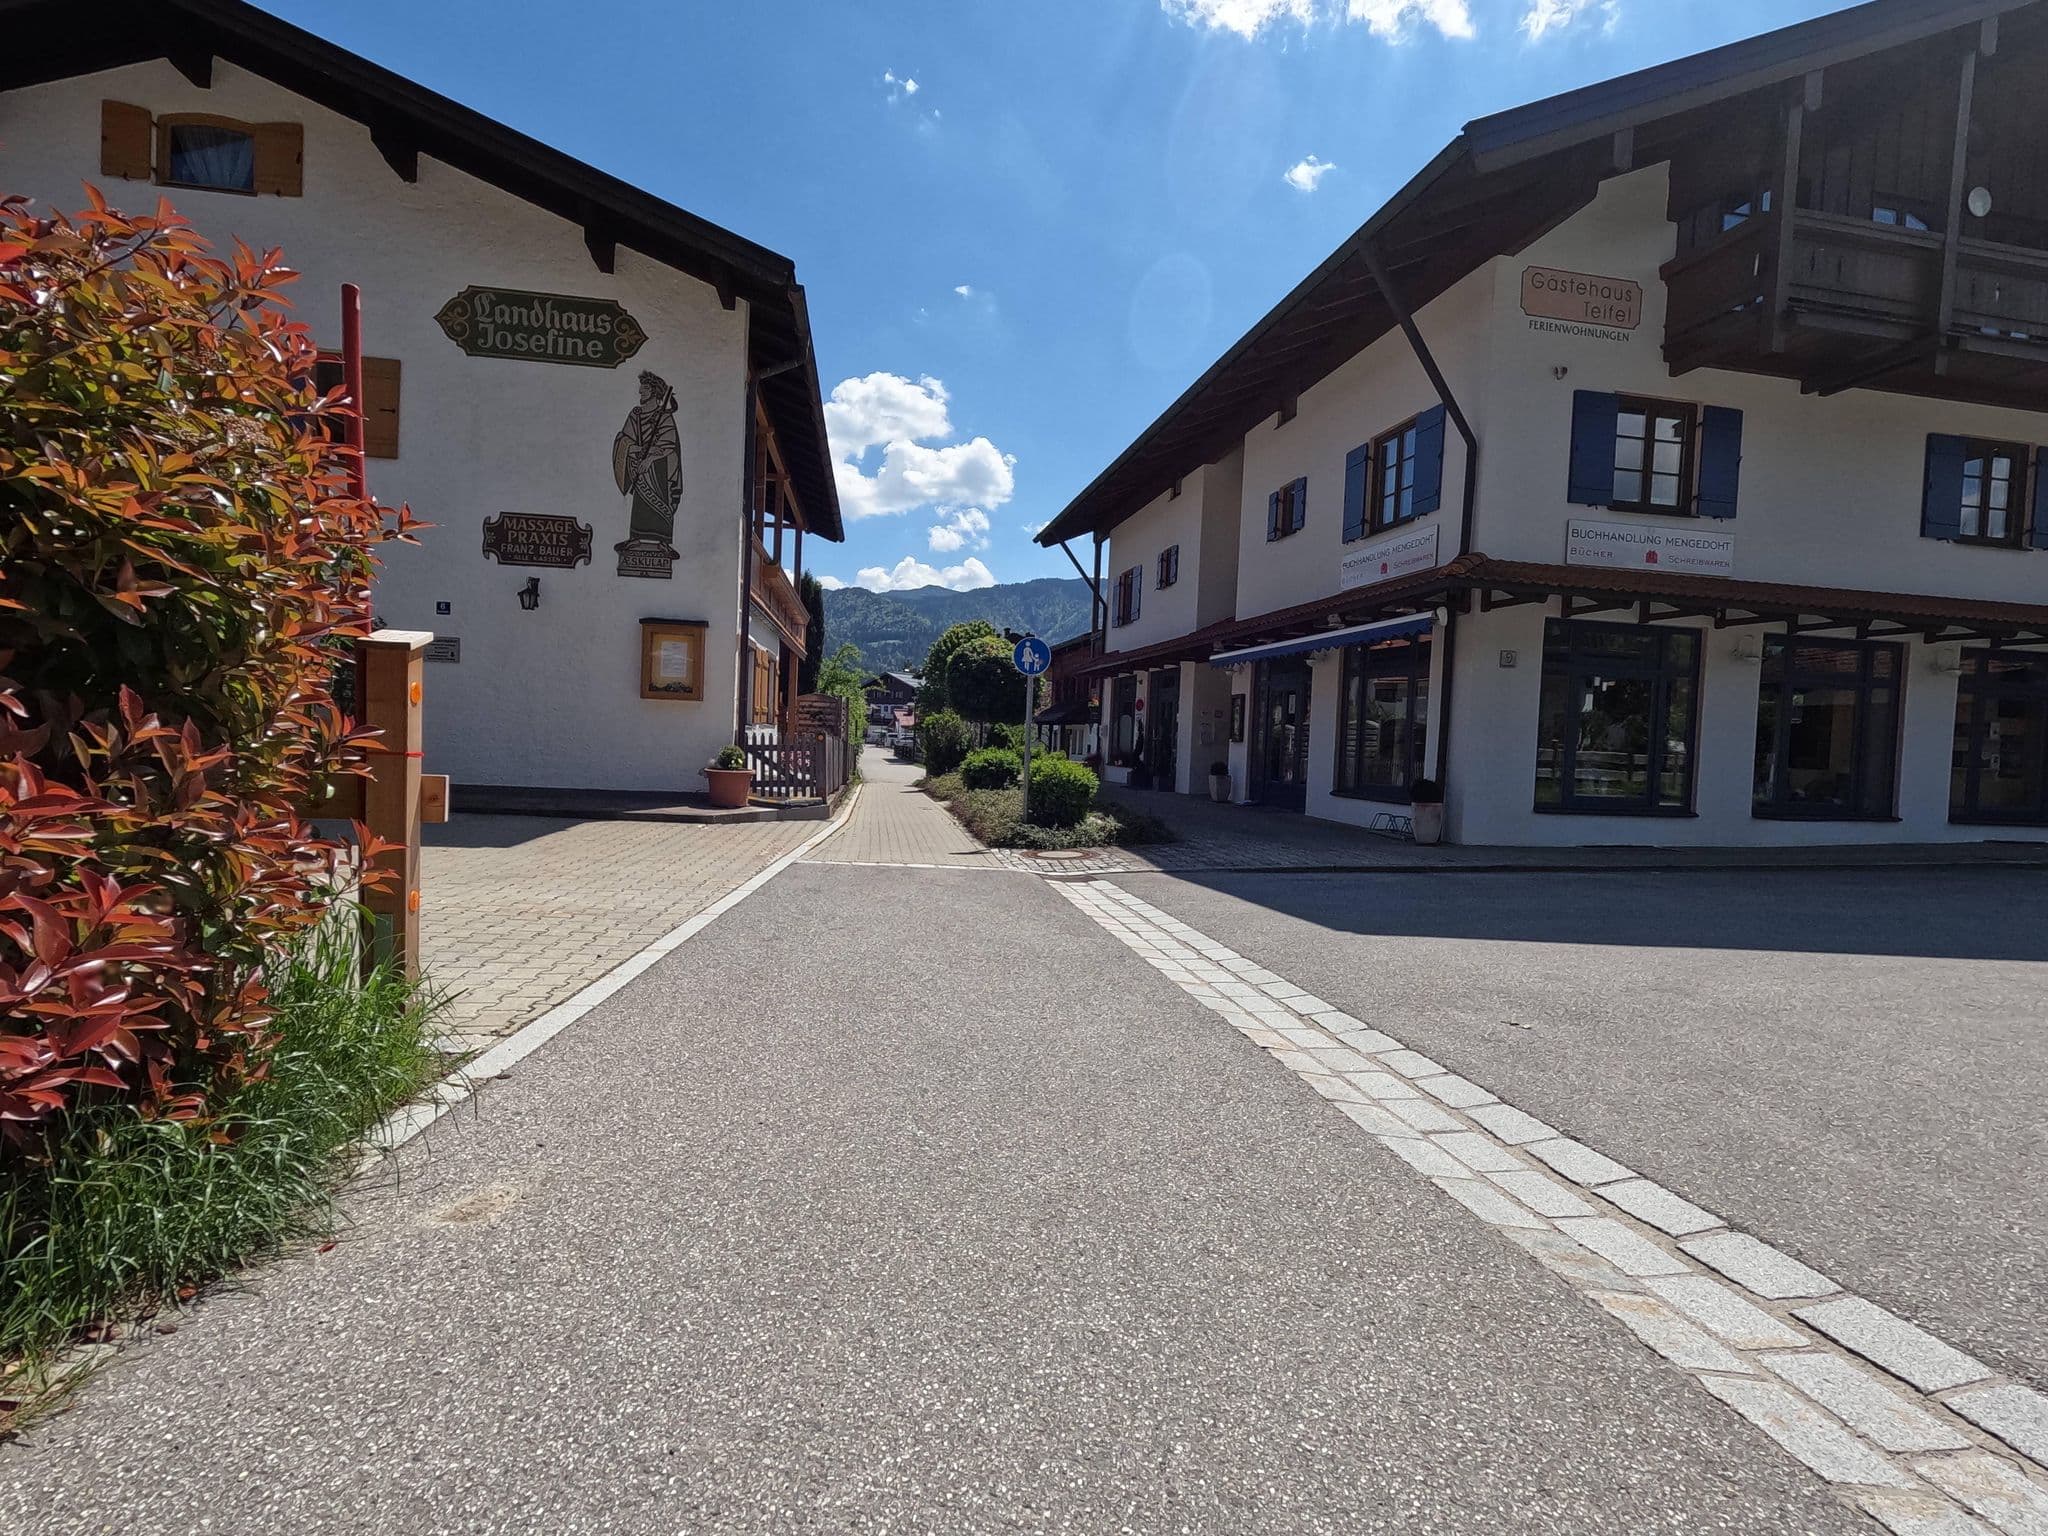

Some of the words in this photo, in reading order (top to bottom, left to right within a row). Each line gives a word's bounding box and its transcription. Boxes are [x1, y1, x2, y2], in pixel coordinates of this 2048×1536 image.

[1531, 272, 1632, 302] Gästehaus
[474, 292, 612, 335] Landhaus
[1584, 301, 1631, 322] Teifel
[1528, 320, 1630, 342] FERIENWOHNUNGEN
[478, 323, 603, 358] Josefine
[504, 517, 573, 534] MASSAGE
[508, 531, 569, 546] PRAXIS
[1392, 534, 1434, 553] MENGEDOHT
[1571, 528, 1662, 545] BUCHHANDLUNG
[1665, 537, 1731, 551] MENGEDOHT
[500, 543, 535, 555] FRANZ
[539, 545, 573, 557] BAUER
[1570, 547, 1614, 559] BÜCHER
[1668, 555, 1730, 568] SCHREIBWAREN
[440, 602, 446, 610] 6
[1505, 652, 1513, 664] 9
